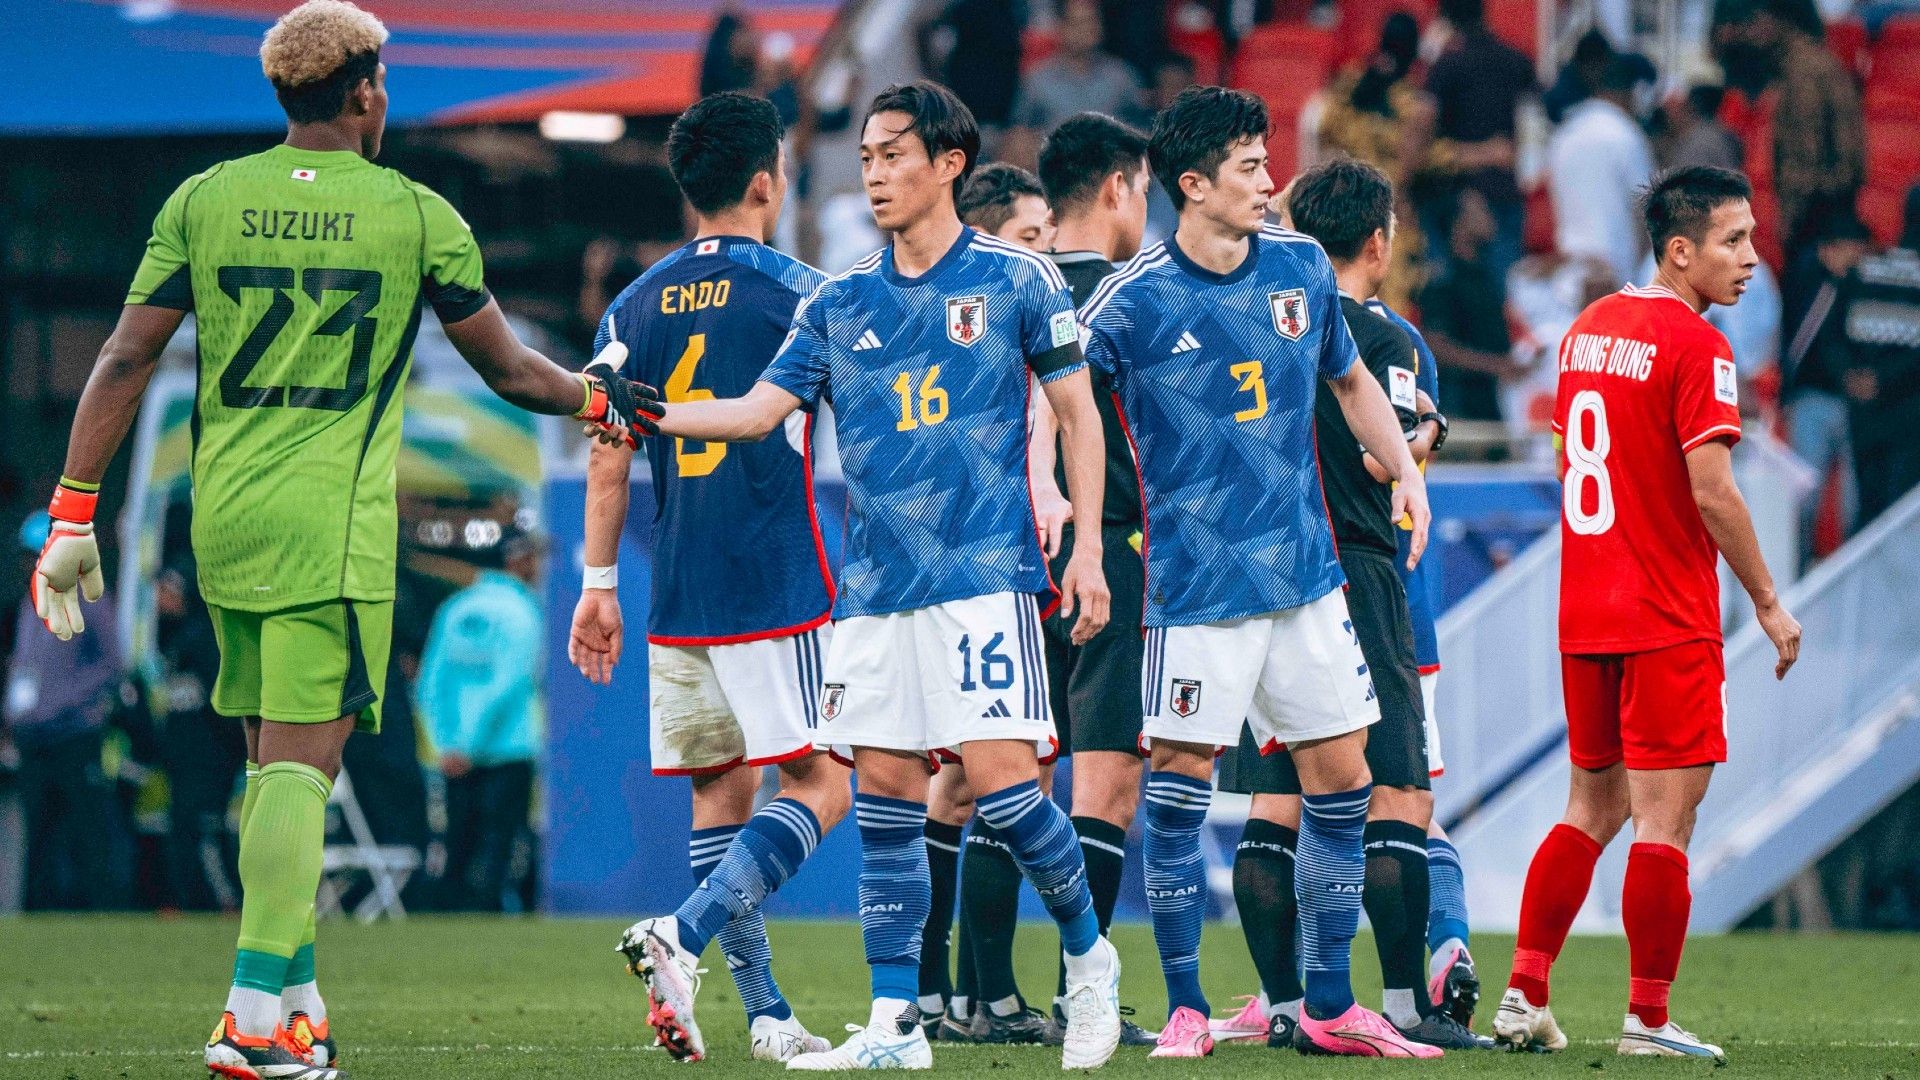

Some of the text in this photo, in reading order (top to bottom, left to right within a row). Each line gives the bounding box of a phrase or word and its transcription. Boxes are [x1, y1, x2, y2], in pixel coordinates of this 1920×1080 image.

[241, 208, 355, 242] SUZUKI
[661, 279, 731, 315] ENDO
[217, 265, 383, 412] 23
[1570, 333, 1612, 374] HUNG
[1606, 337, 1657, 382] DUNG
[664, 333, 727, 478] 6
[892, 364, 949, 432] 16
[1229, 360, 1269, 423] 3
[1564, 390, 1616, 535] 8
[958, 632, 1015, 692] 16
[859, 903, 904, 916] PAN
[1145, 885, 1198, 899] APAN
